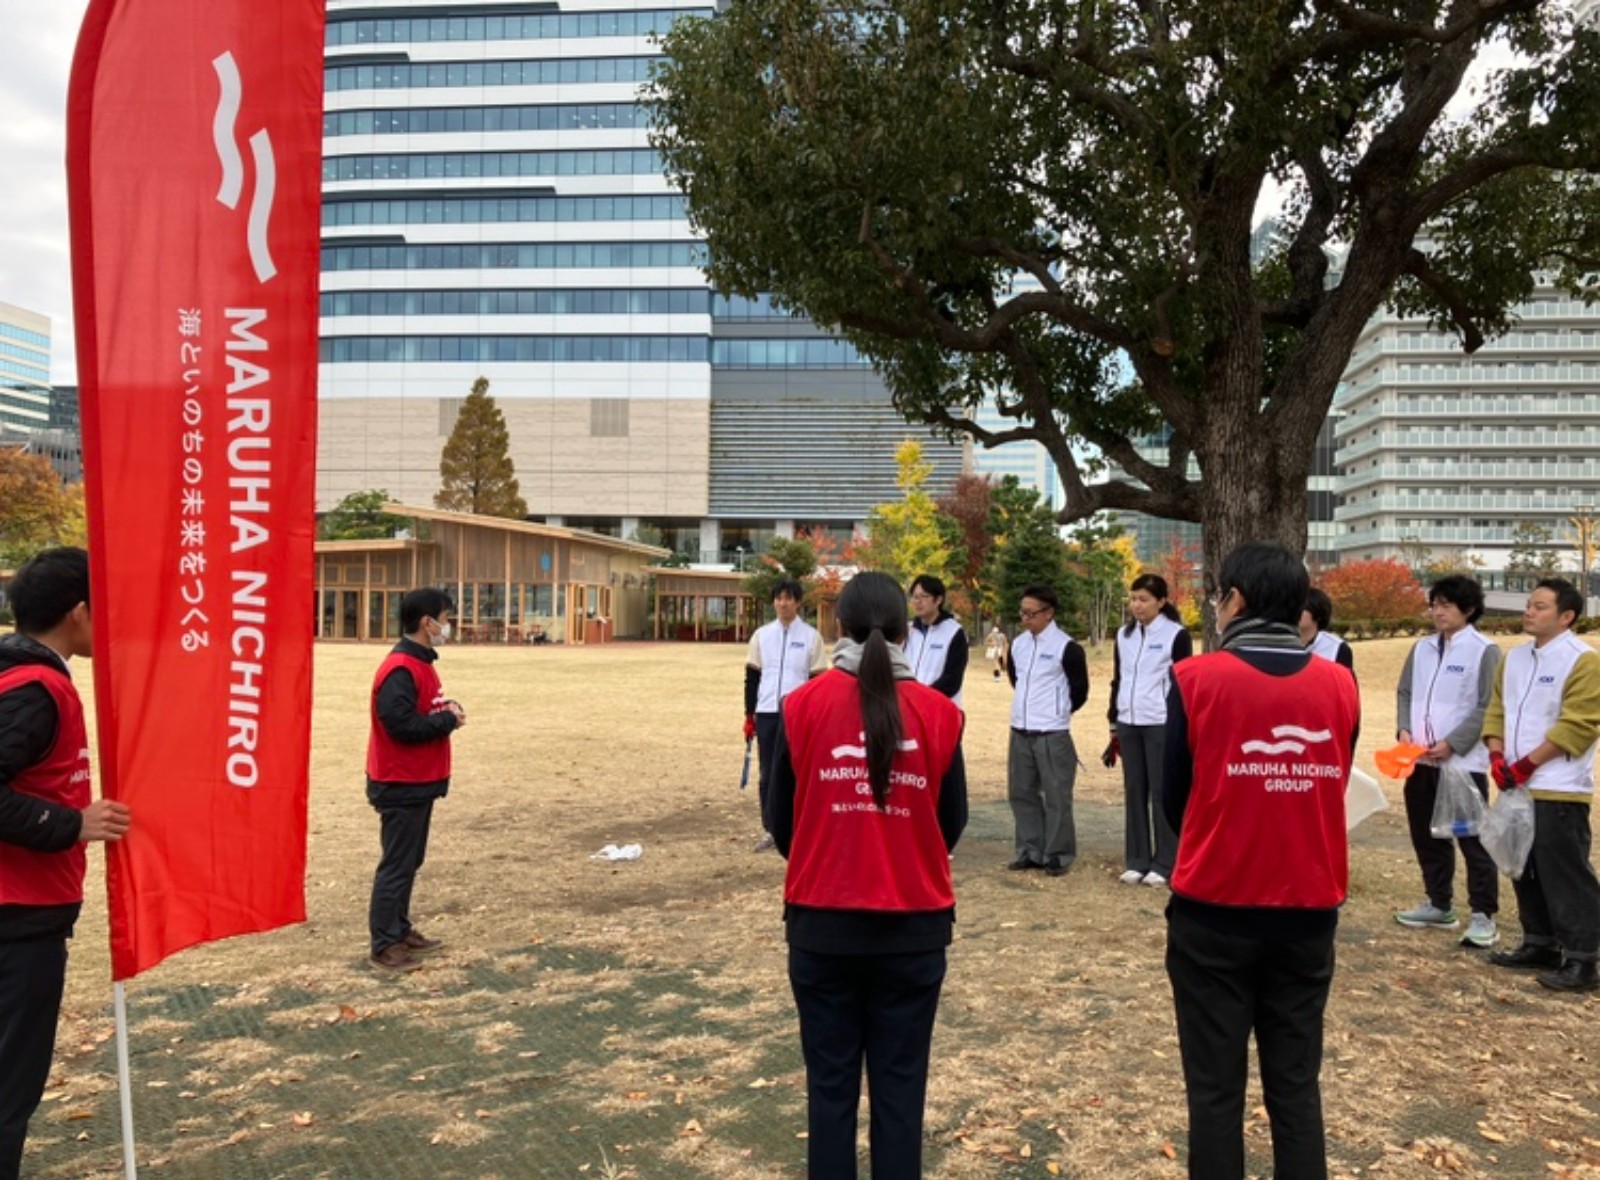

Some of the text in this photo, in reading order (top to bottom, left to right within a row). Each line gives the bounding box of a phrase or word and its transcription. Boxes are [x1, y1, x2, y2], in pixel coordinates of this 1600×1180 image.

[177, 307, 209, 652] 海といのちの未来をつくる
[224, 307, 270, 788] MARUHA NICHIRO
[888, 770, 927, 790] CHIRO
[1227, 762, 1342, 780] MARUHA NICHIRO
[1264, 778, 1313, 792] GROUP
